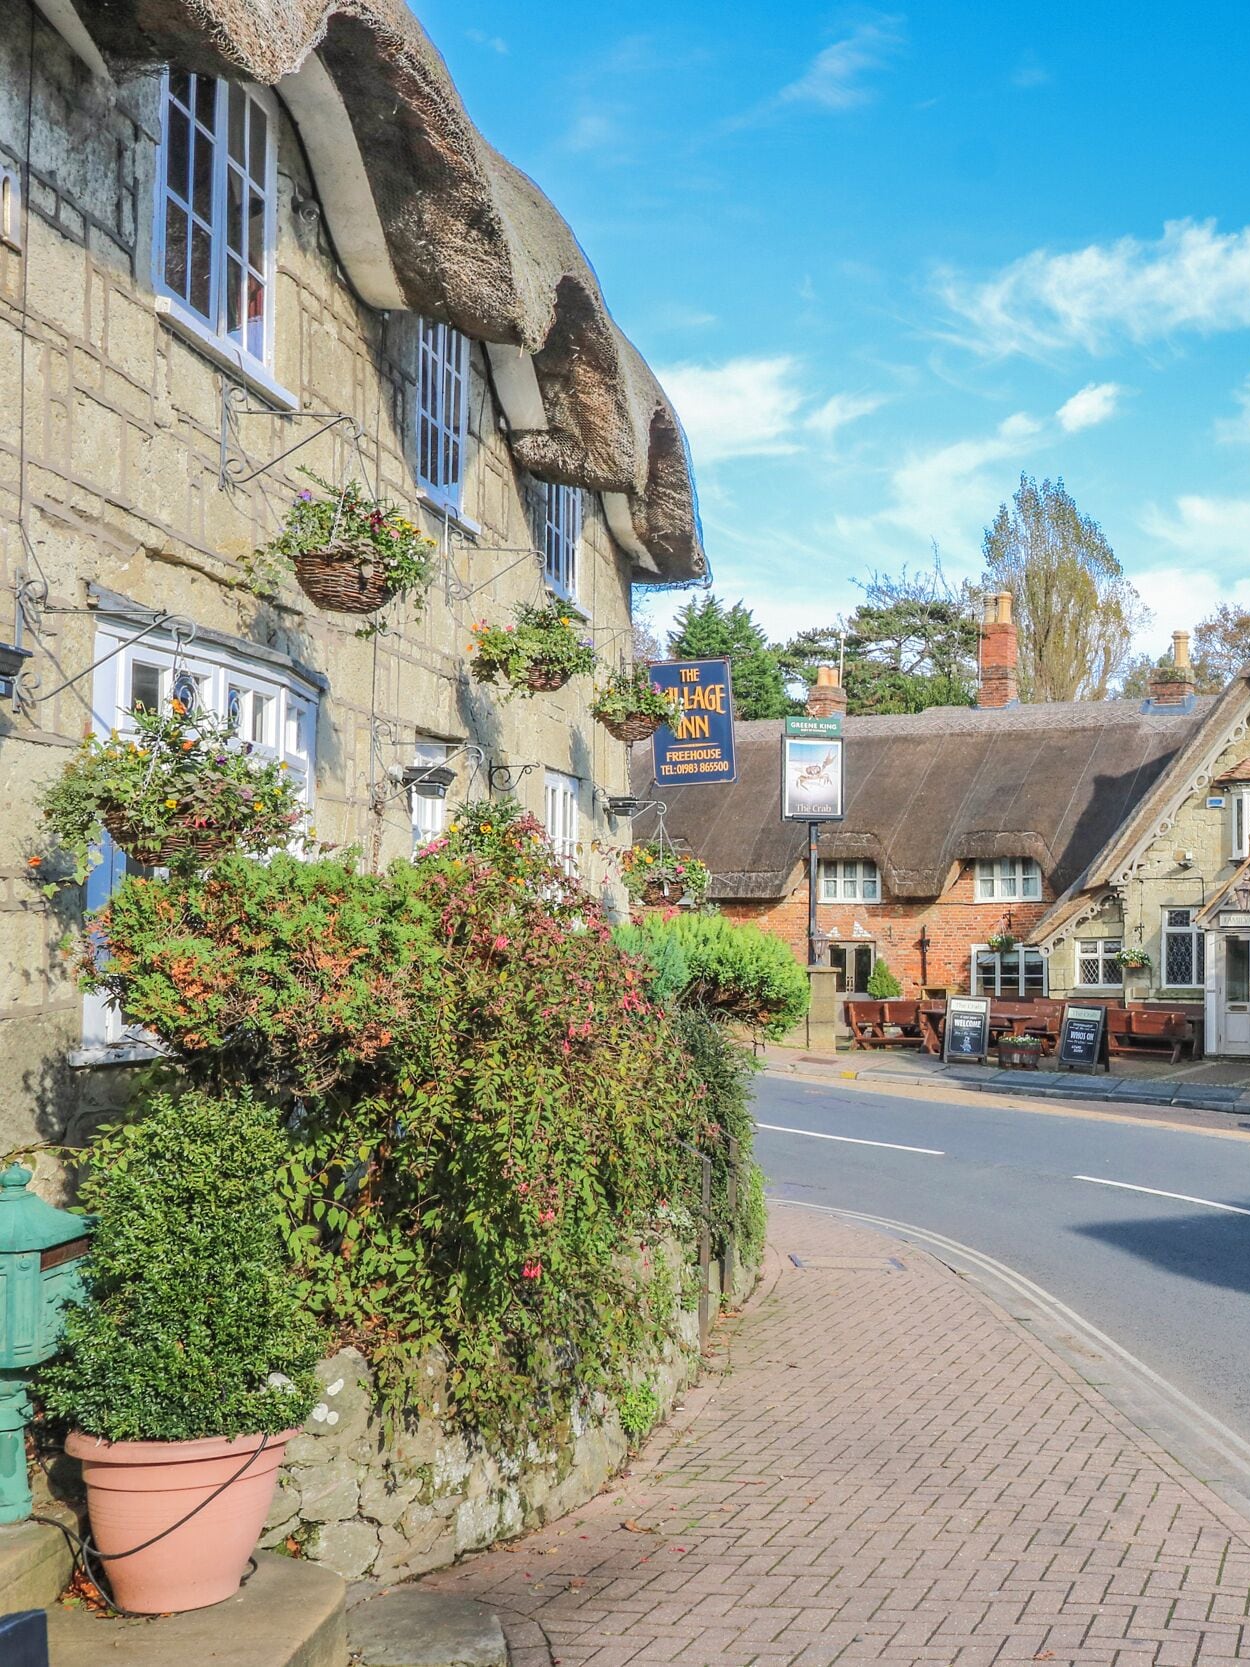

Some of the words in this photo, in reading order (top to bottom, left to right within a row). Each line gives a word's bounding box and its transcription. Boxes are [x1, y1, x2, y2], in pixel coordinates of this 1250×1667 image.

[680, 668, 700, 683] THE
[665, 684, 727, 714] ILLAGE
[677, 715, 709, 739] INN
[790, 721, 818, 730] GREENE
[819, 723, 837, 731] KING
[666, 749, 721, 762] FREEHOUSE
[699, 760, 729, 773] 865500
[796, 804, 811, 813] The
[812, 804, 832, 814] Crab
[954, 1019, 982, 1028] WELCOME
